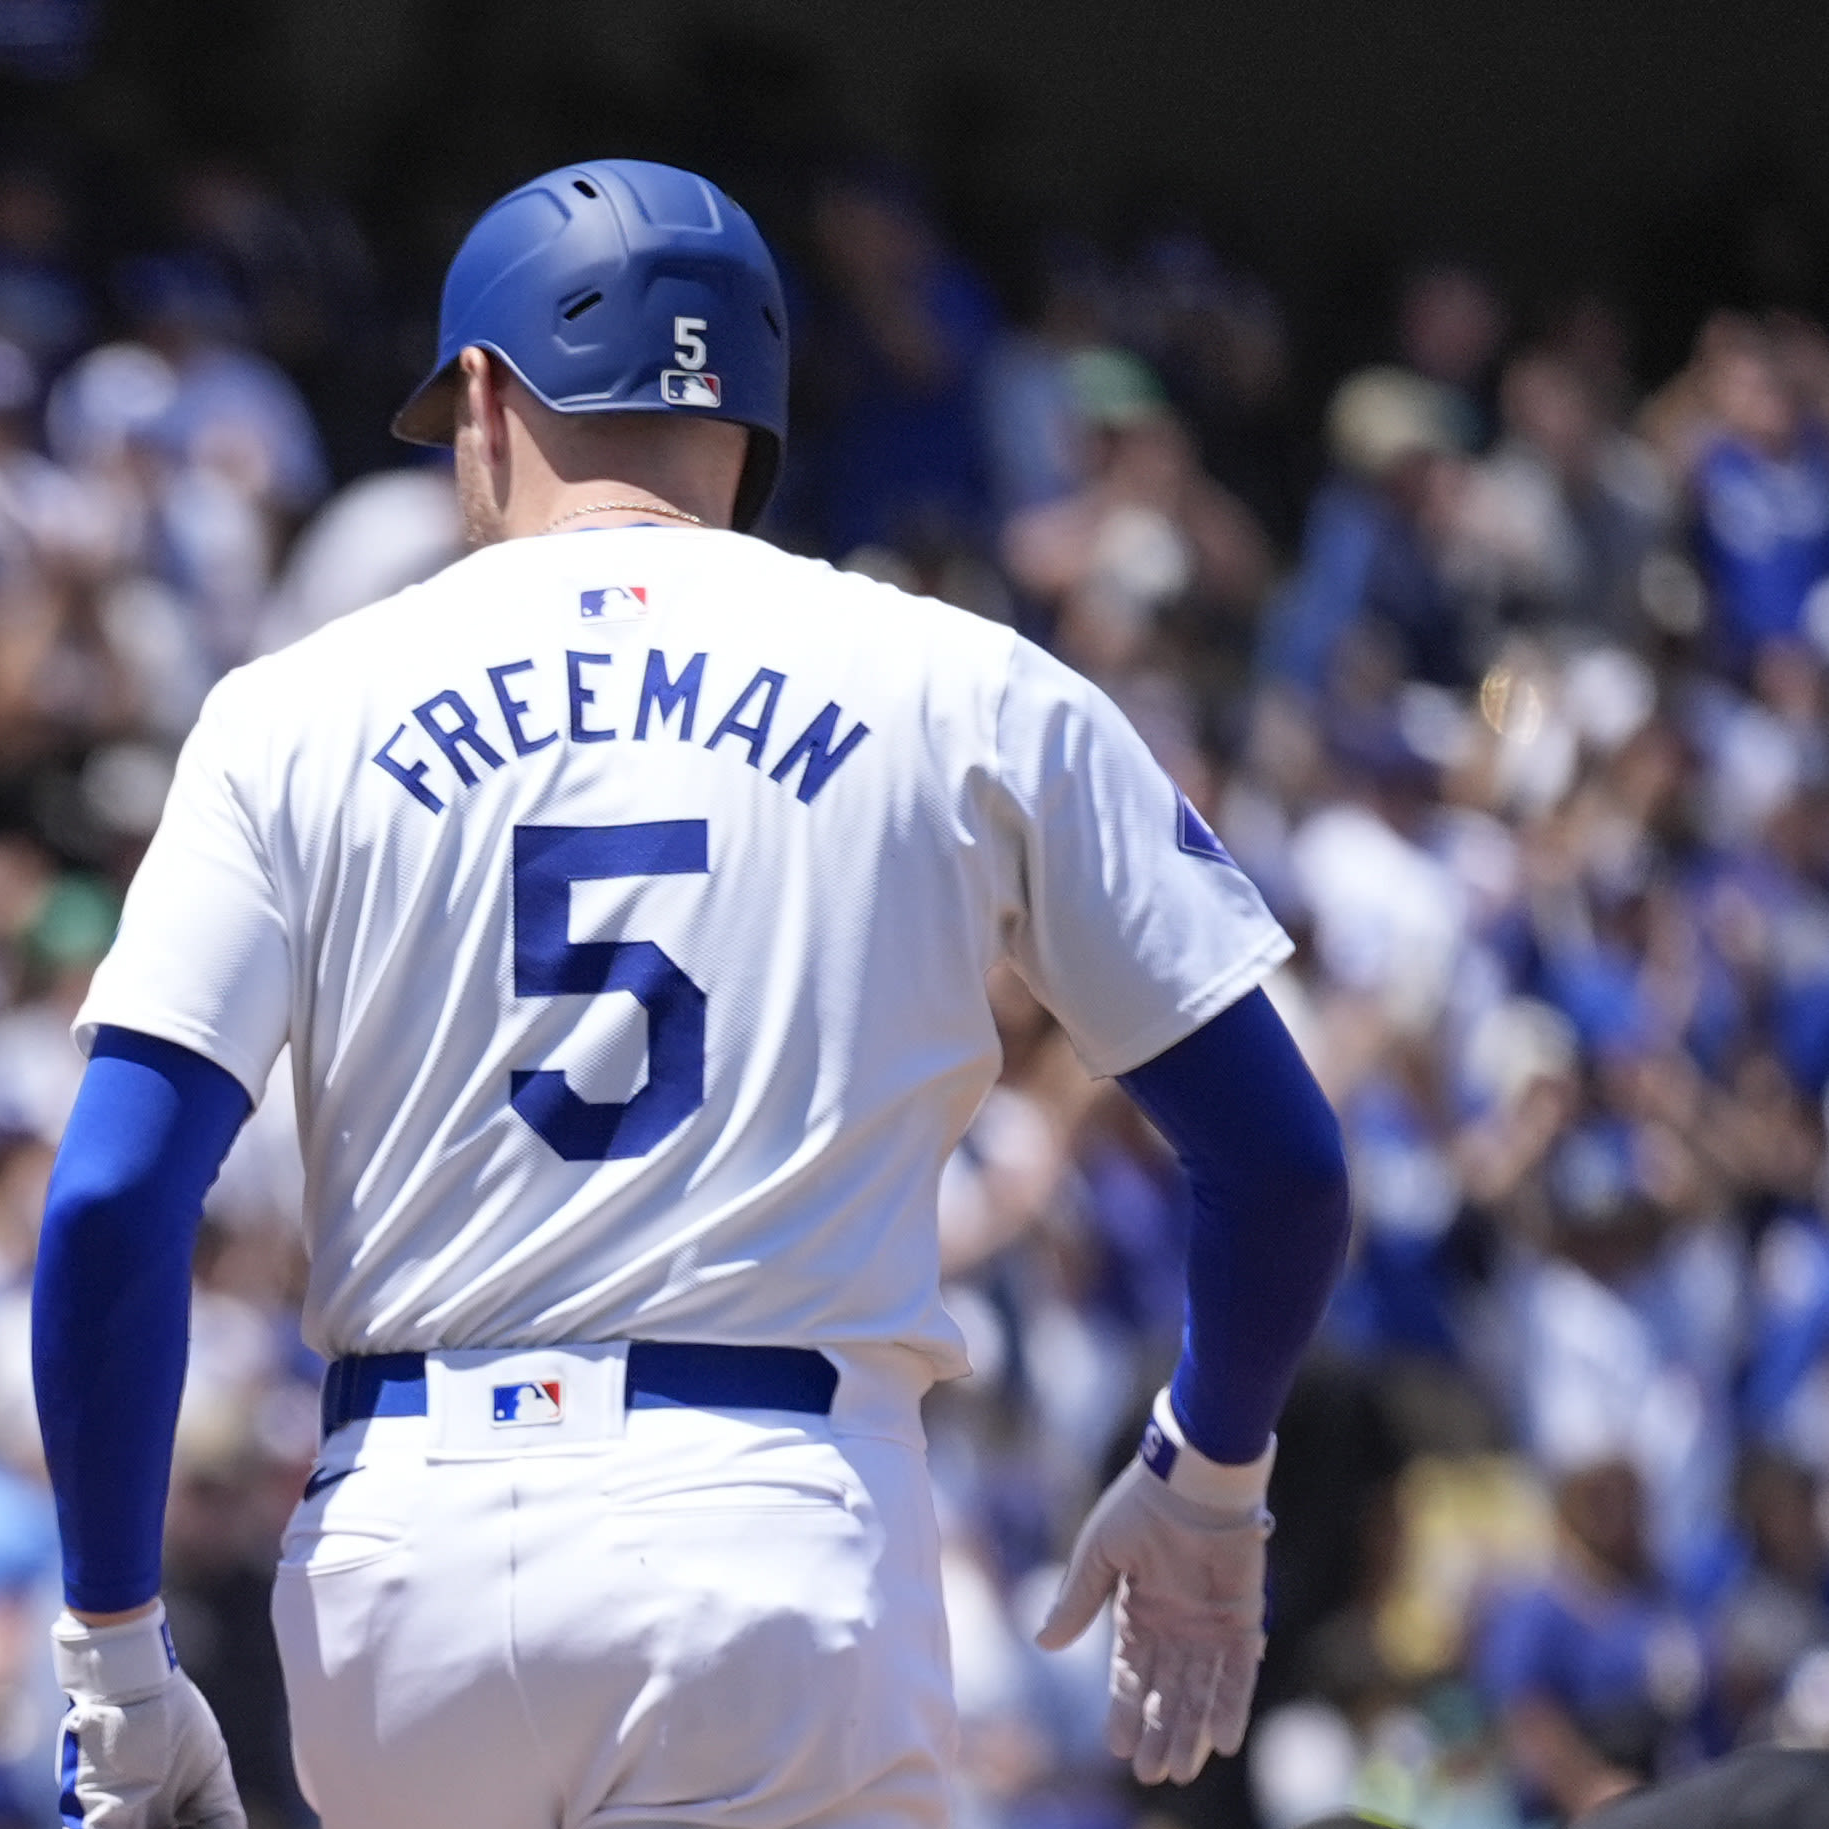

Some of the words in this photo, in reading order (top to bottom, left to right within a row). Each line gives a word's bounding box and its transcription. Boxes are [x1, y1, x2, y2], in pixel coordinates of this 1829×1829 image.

[674, 316, 707, 370] 5
[372, 648, 872, 816] FREEMAN
[510, 819, 709, 1161] 5
